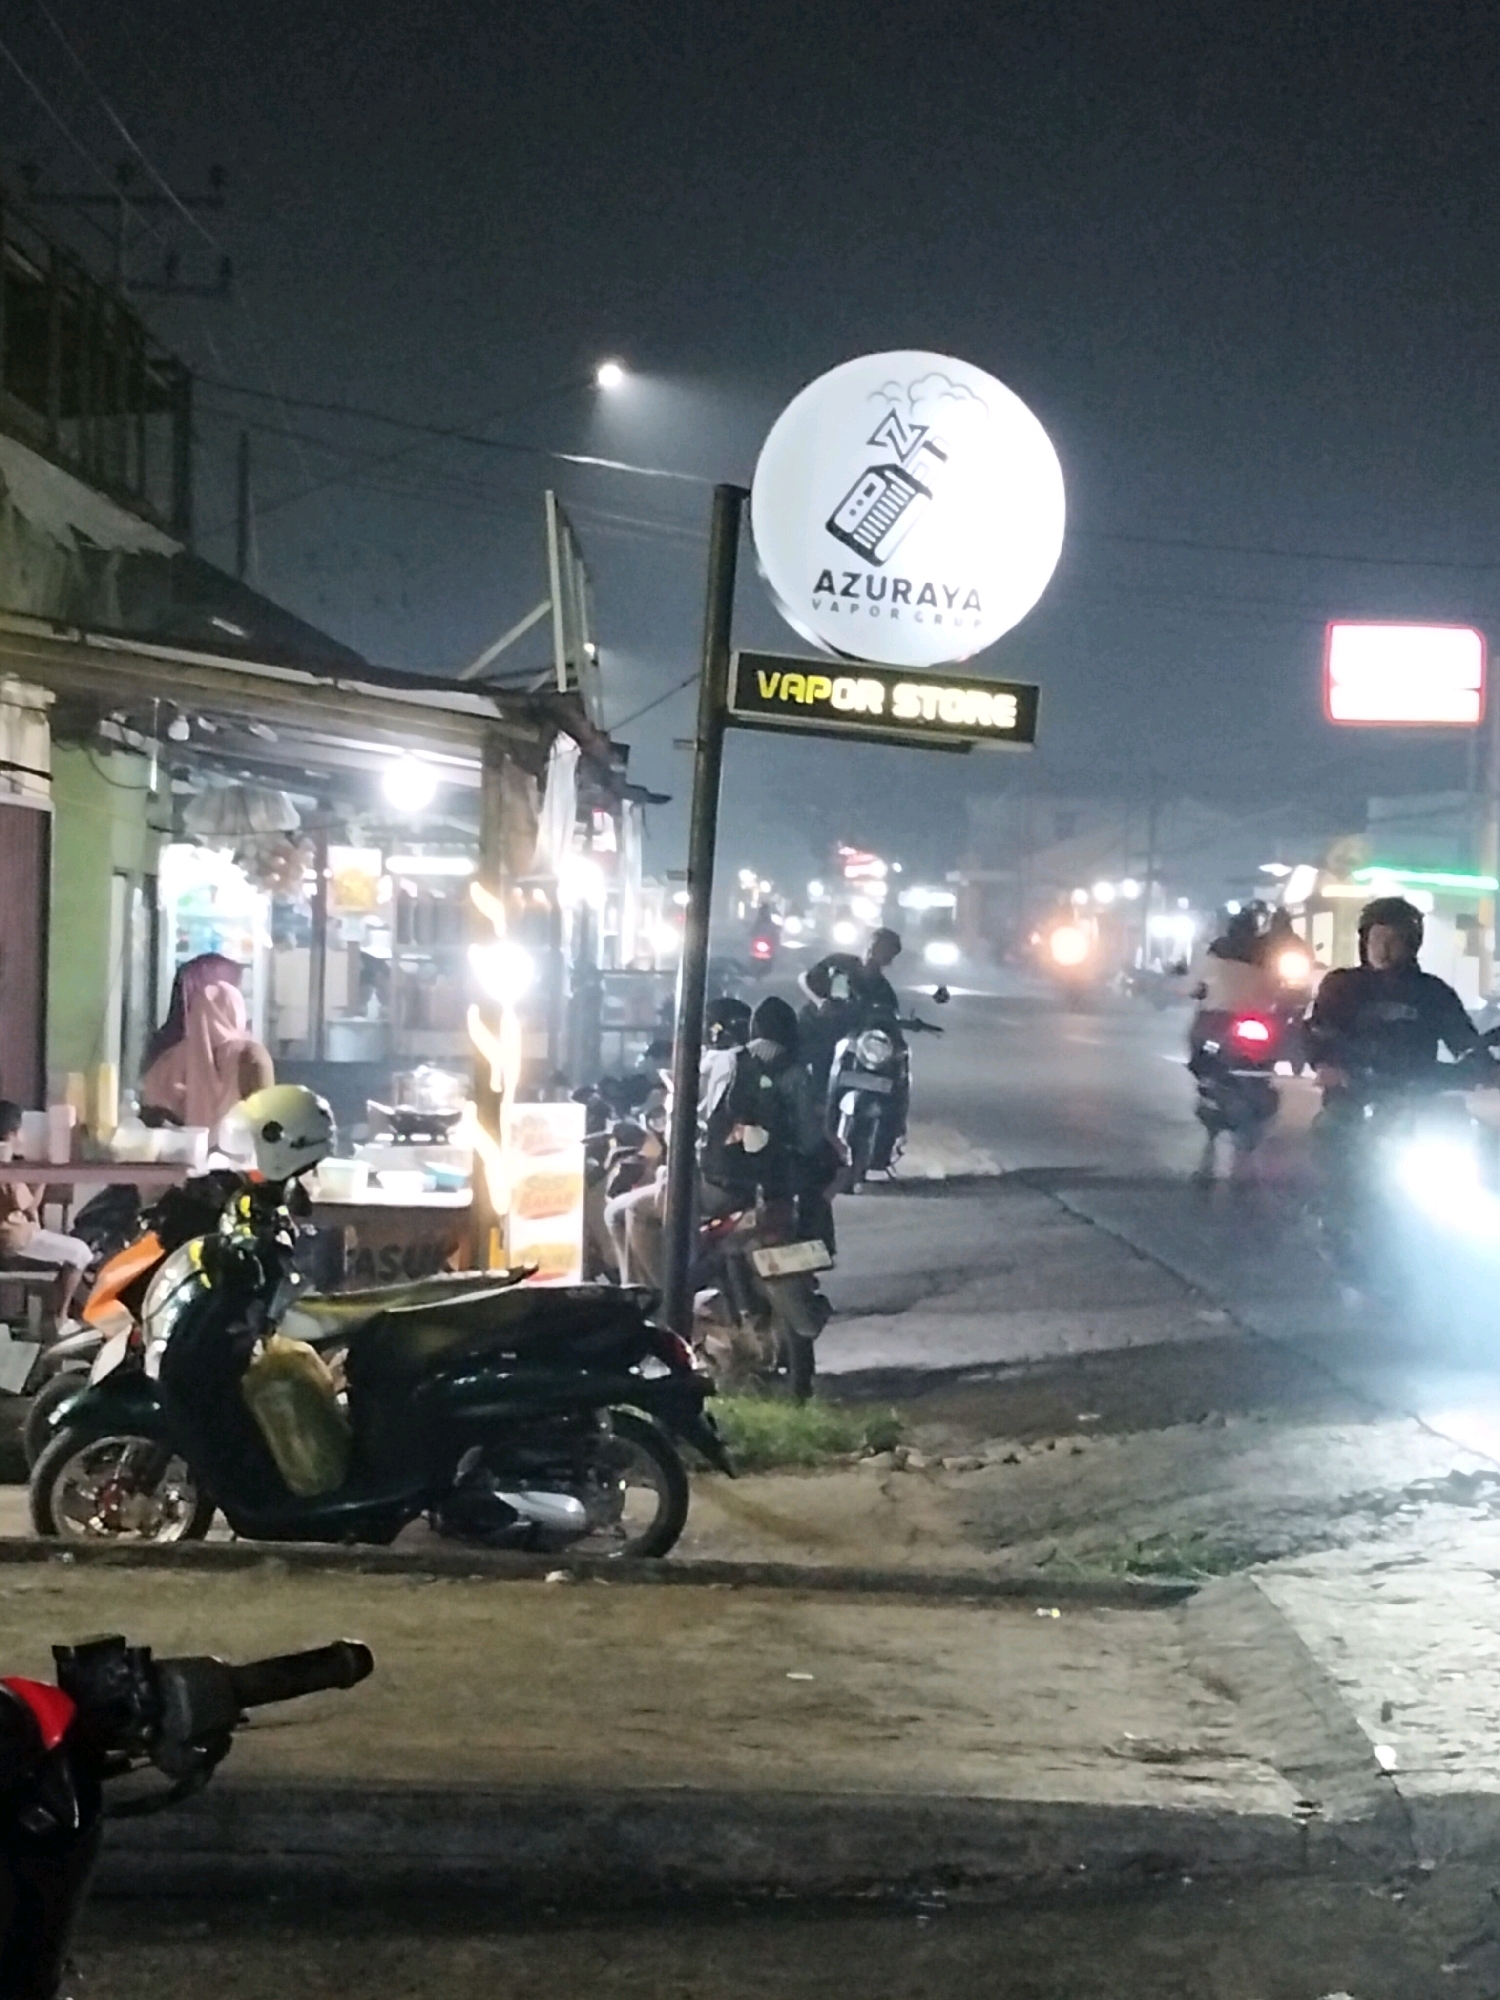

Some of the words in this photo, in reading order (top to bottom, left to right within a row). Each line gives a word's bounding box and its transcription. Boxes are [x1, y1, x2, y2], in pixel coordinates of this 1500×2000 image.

[811, 597, 900, 620] VAPOR
[812, 568, 982, 612] AZURAYA
[757, 669, 885, 714] VAPOR
[891, 683, 1017, 729] STORE
